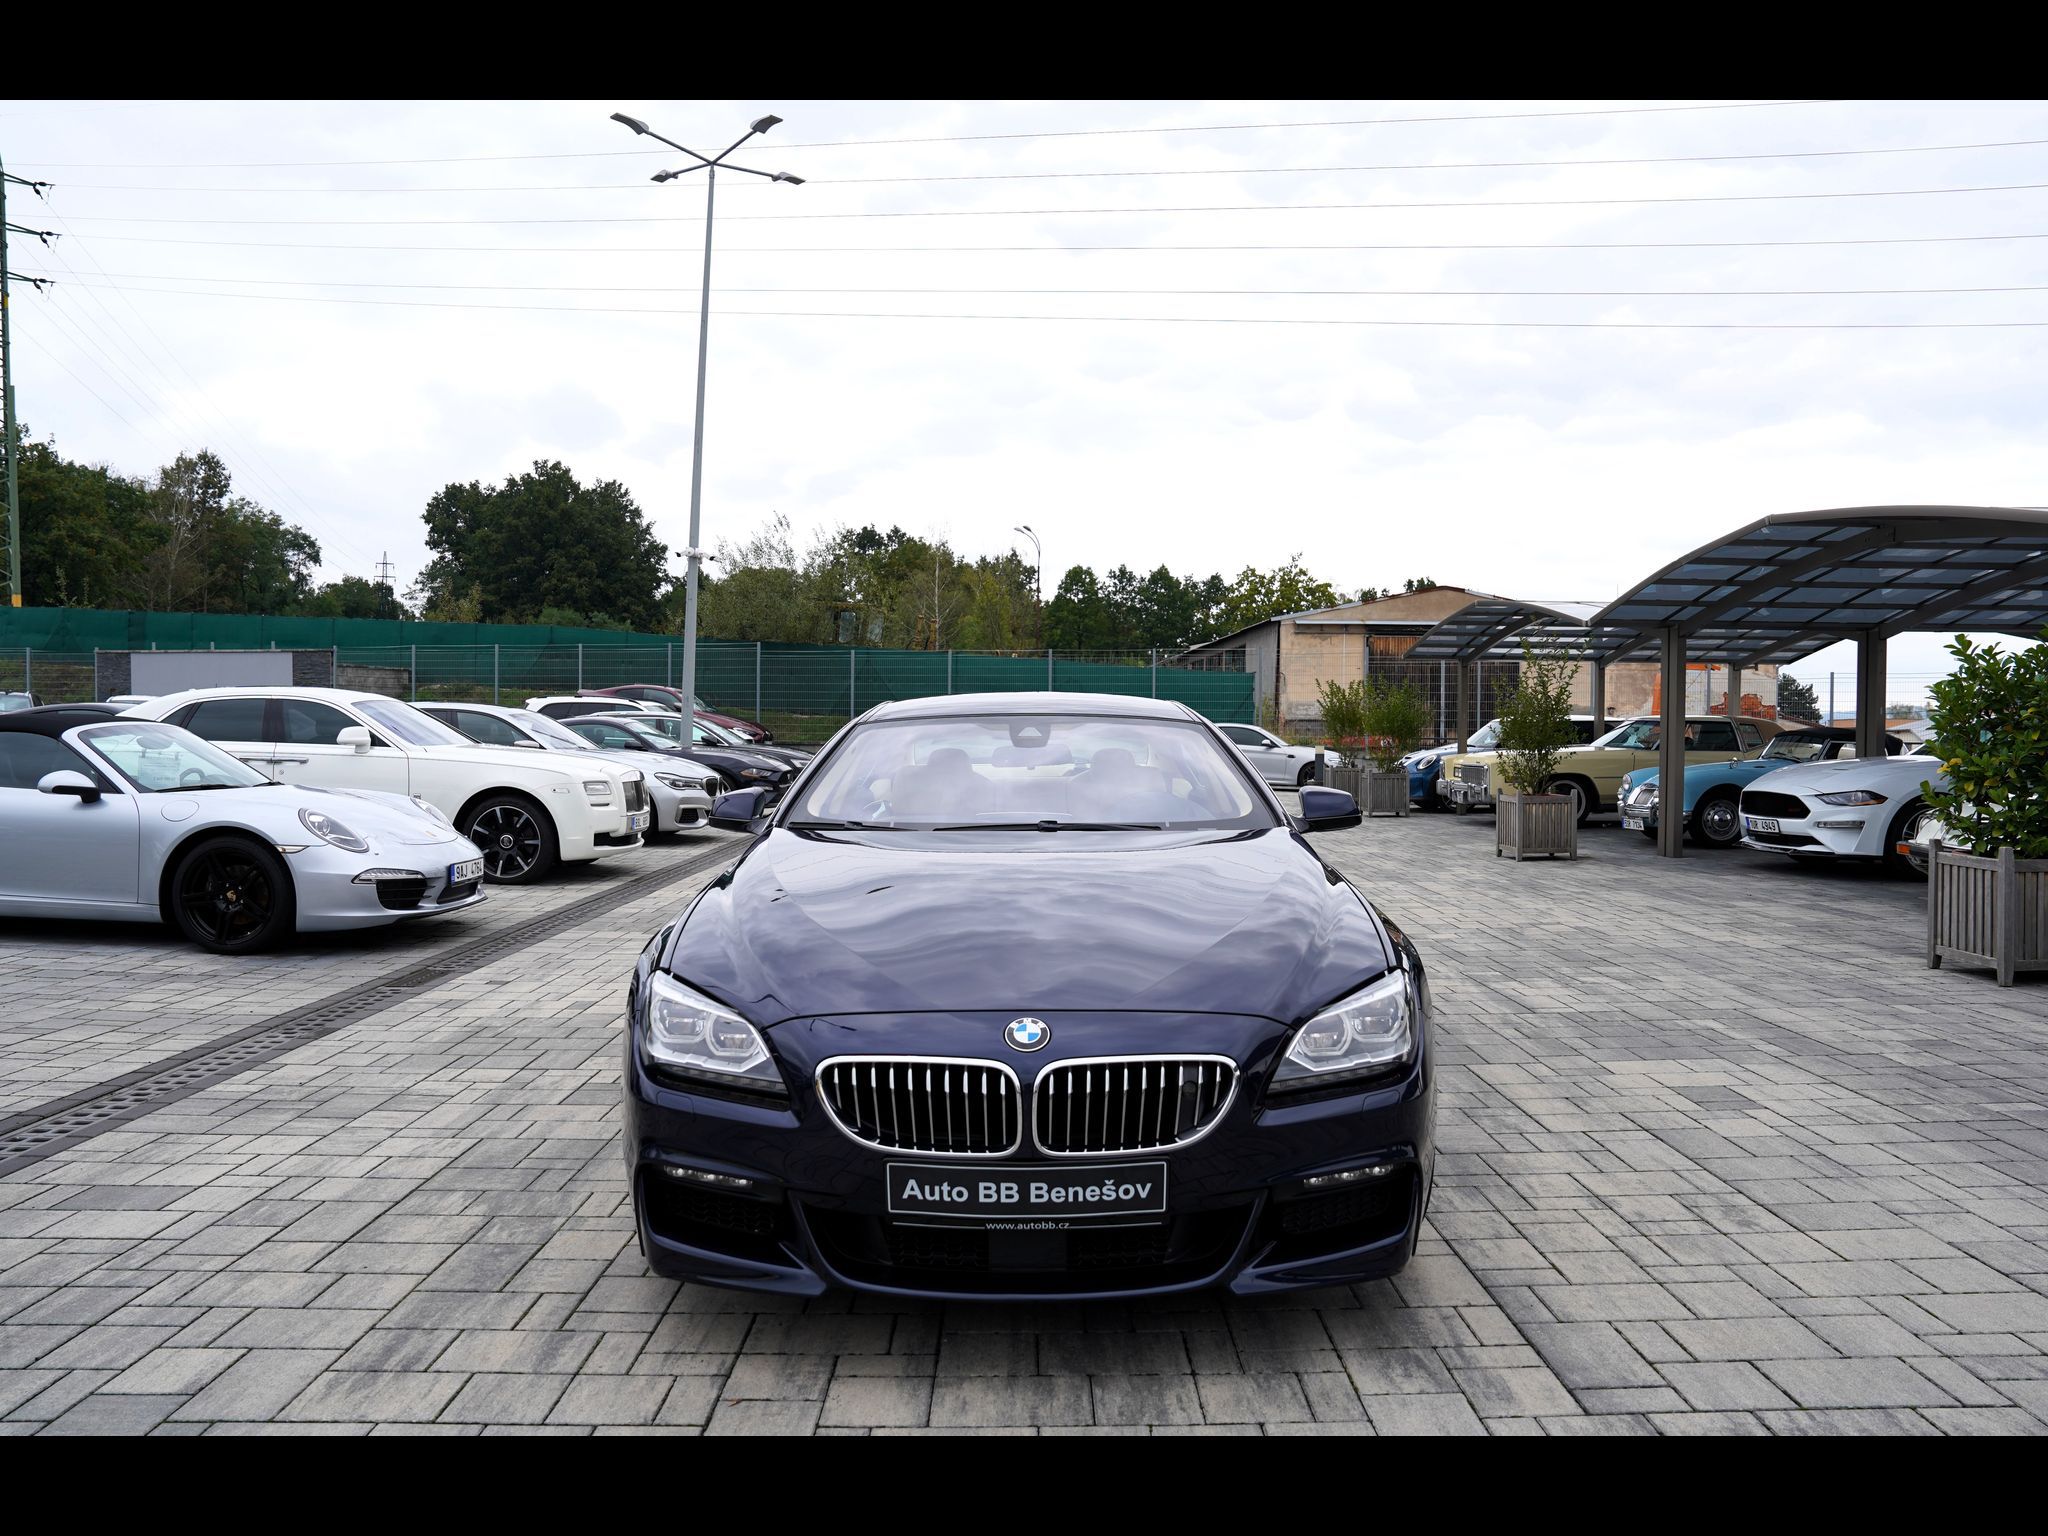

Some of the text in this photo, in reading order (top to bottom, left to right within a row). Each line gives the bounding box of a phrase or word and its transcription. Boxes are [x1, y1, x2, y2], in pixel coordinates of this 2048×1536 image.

[1761, 820, 1776, 831] 4949
[455, 863, 468, 879] 9AJ
[902, 1178, 1153, 1203] Auto BB Benešov
[985, 1221, 1070, 1231] www.autobb.cz
